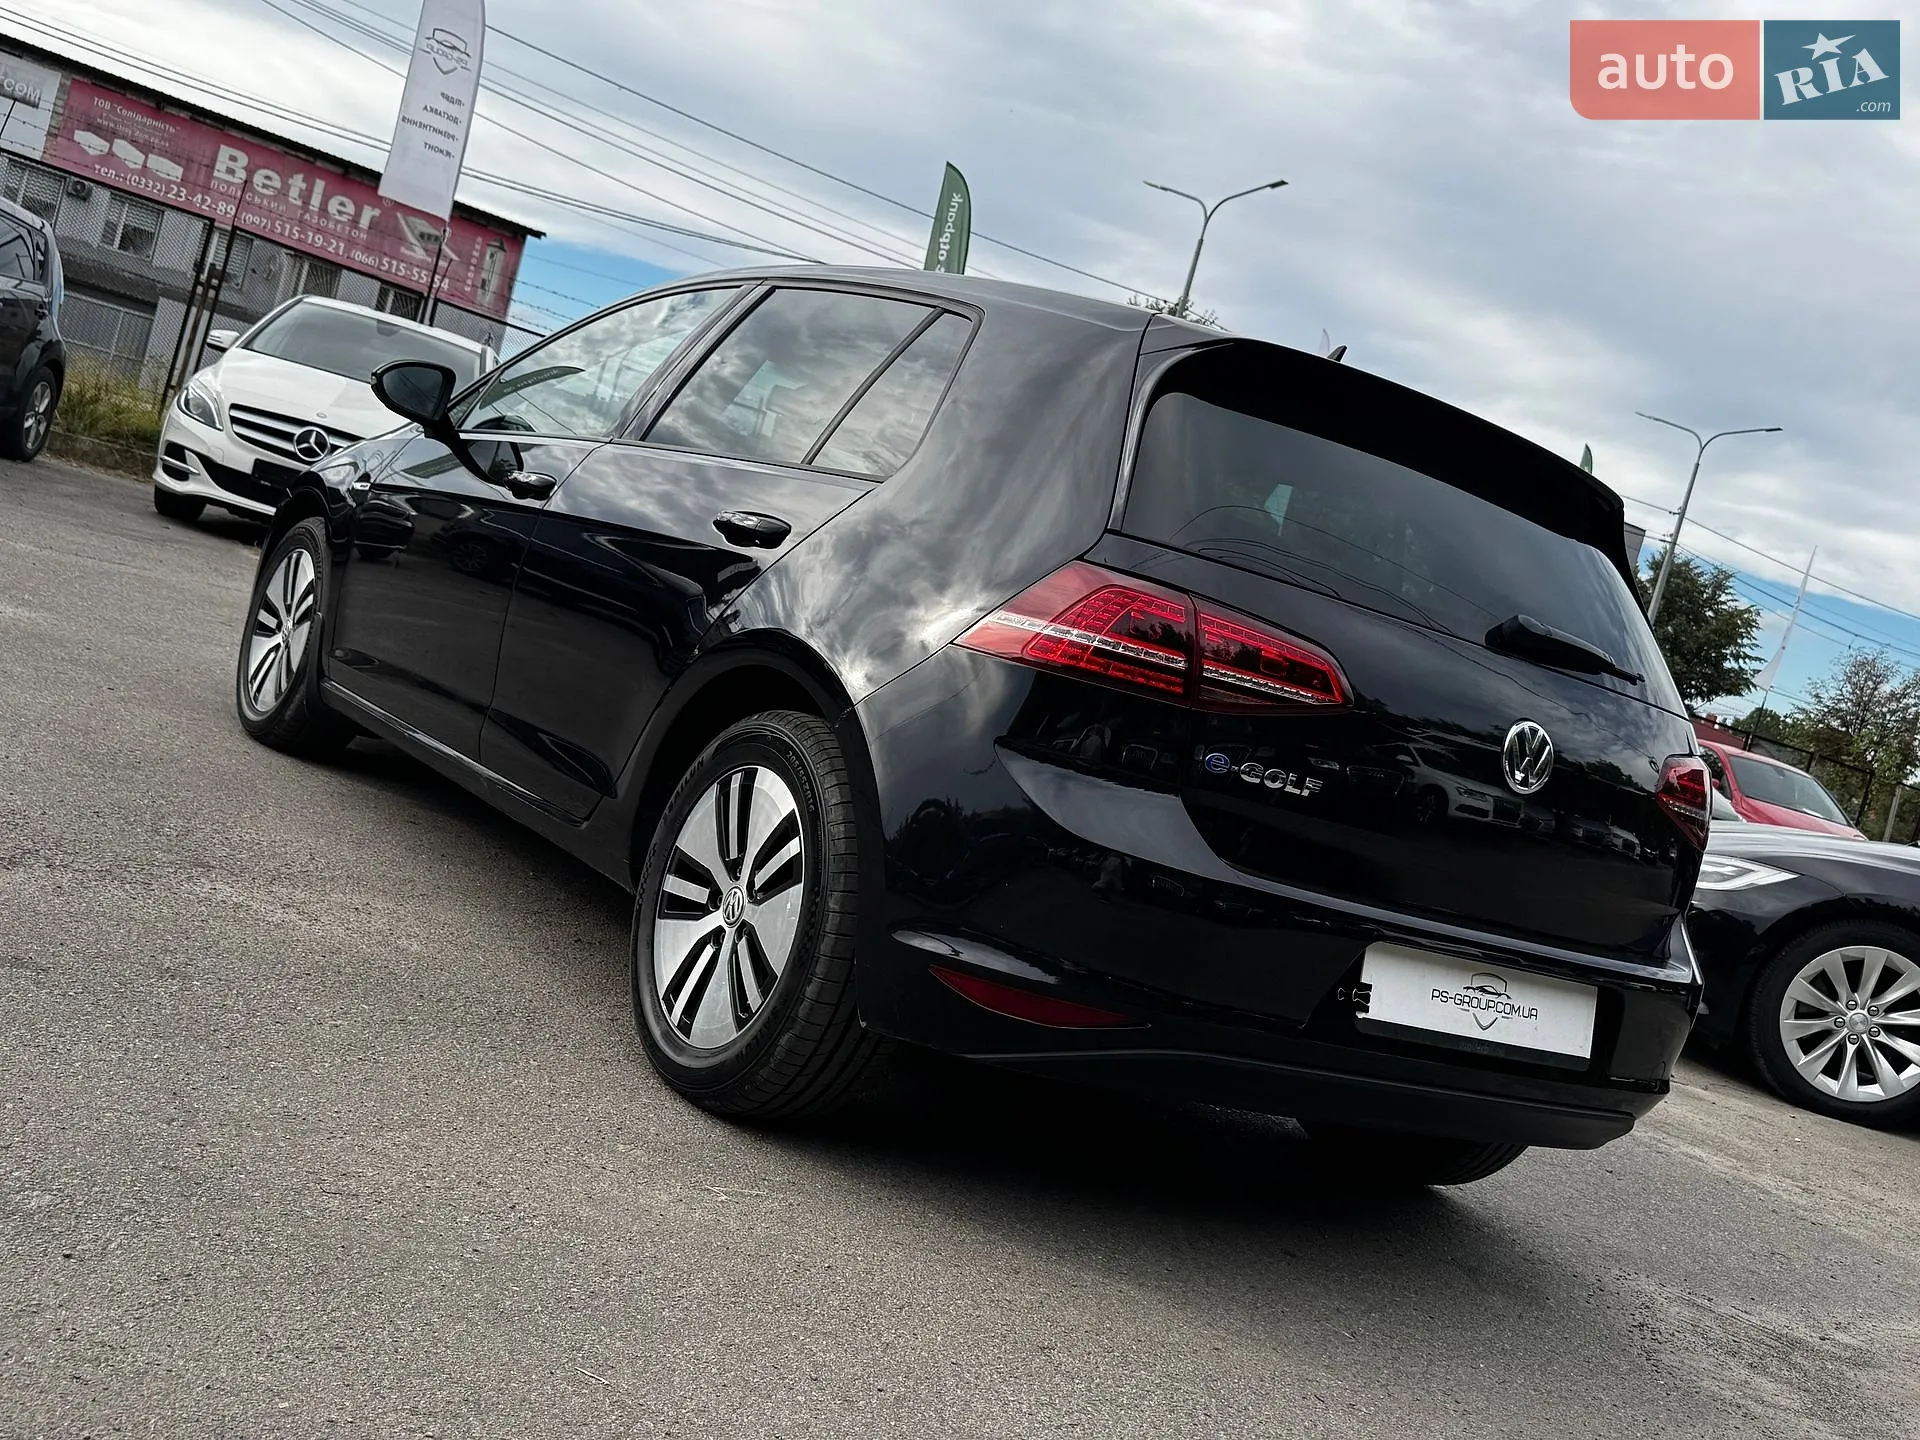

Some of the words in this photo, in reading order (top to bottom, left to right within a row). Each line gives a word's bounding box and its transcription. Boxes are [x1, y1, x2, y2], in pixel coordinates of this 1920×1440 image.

[94, 96, 111, 110] ТОВ
[212, 143, 381, 230] Betler
[125, 173, 165, 196] (0332)
[241, 211, 272, 233] (097)
[351, 249, 379, 268] (066)
[1204, 752, 1324, 797] e-GOLF
[1431, 988, 1539, 1021] PS-GROUP.COM.UA
